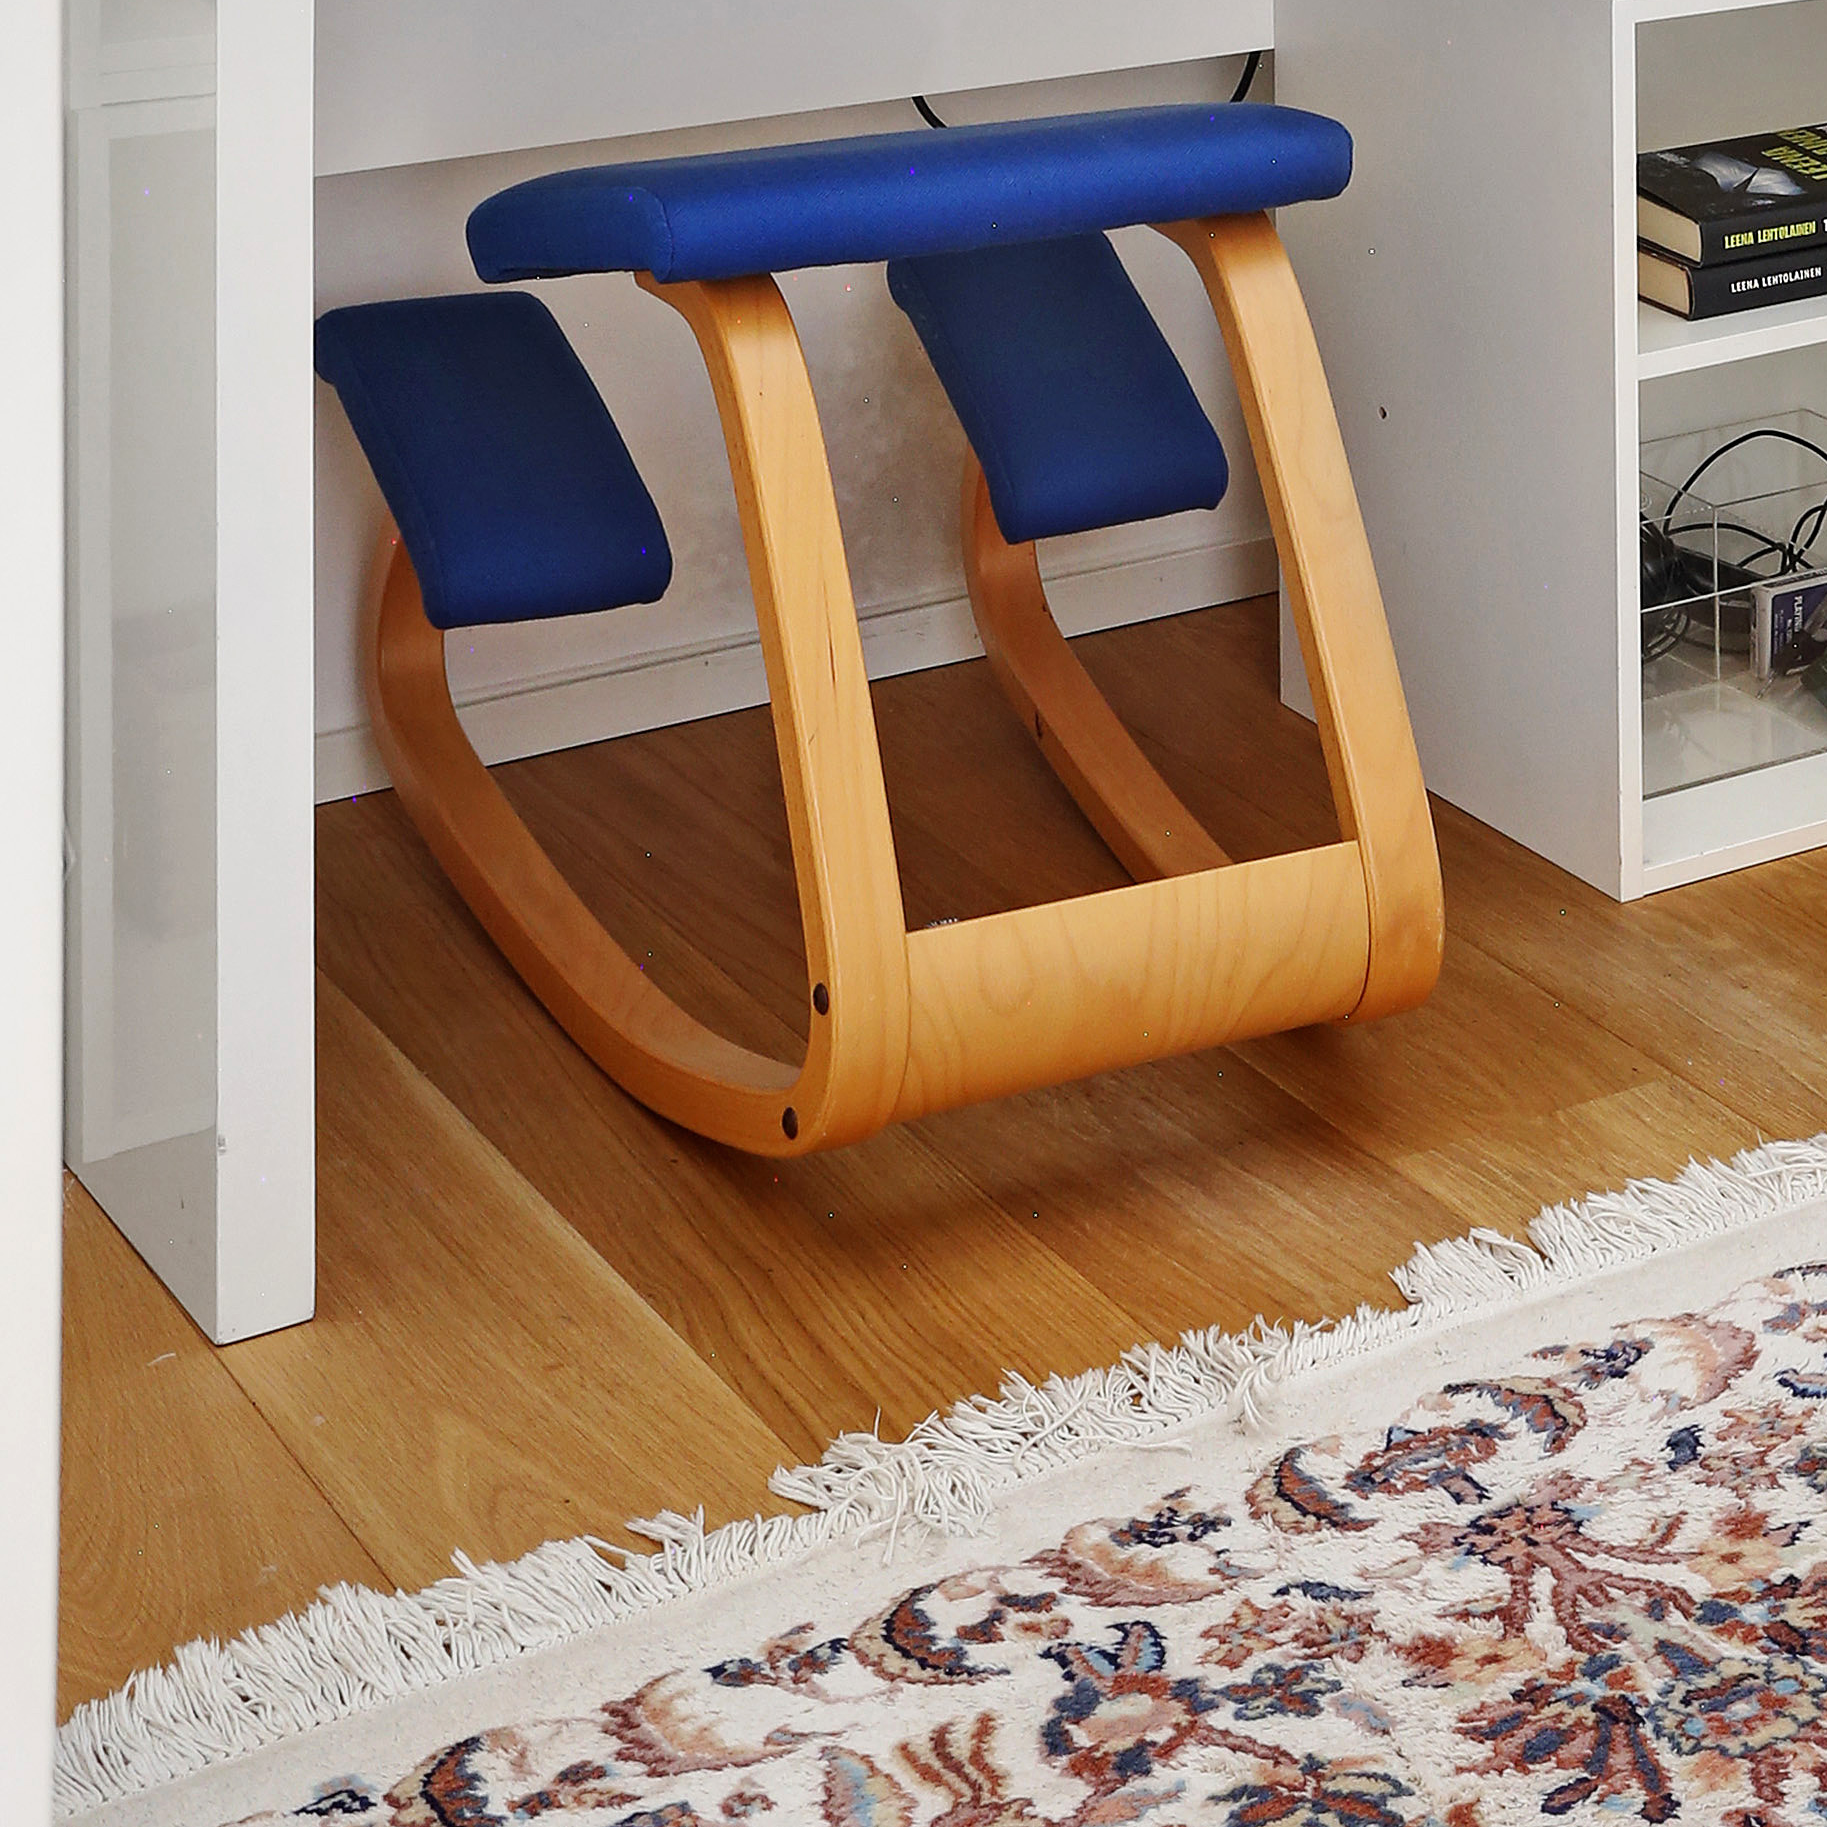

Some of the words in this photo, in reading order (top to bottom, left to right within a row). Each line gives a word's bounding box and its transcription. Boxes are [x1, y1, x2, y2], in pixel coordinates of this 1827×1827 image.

[1723, 232, 1755, 250] LEENA
[1757, 220, 1817, 244] LEHTOLAINEN
[1730, 279, 1760, 294] LEENA
[1761, 266, 1822, 288] LEHTOLAINEN
